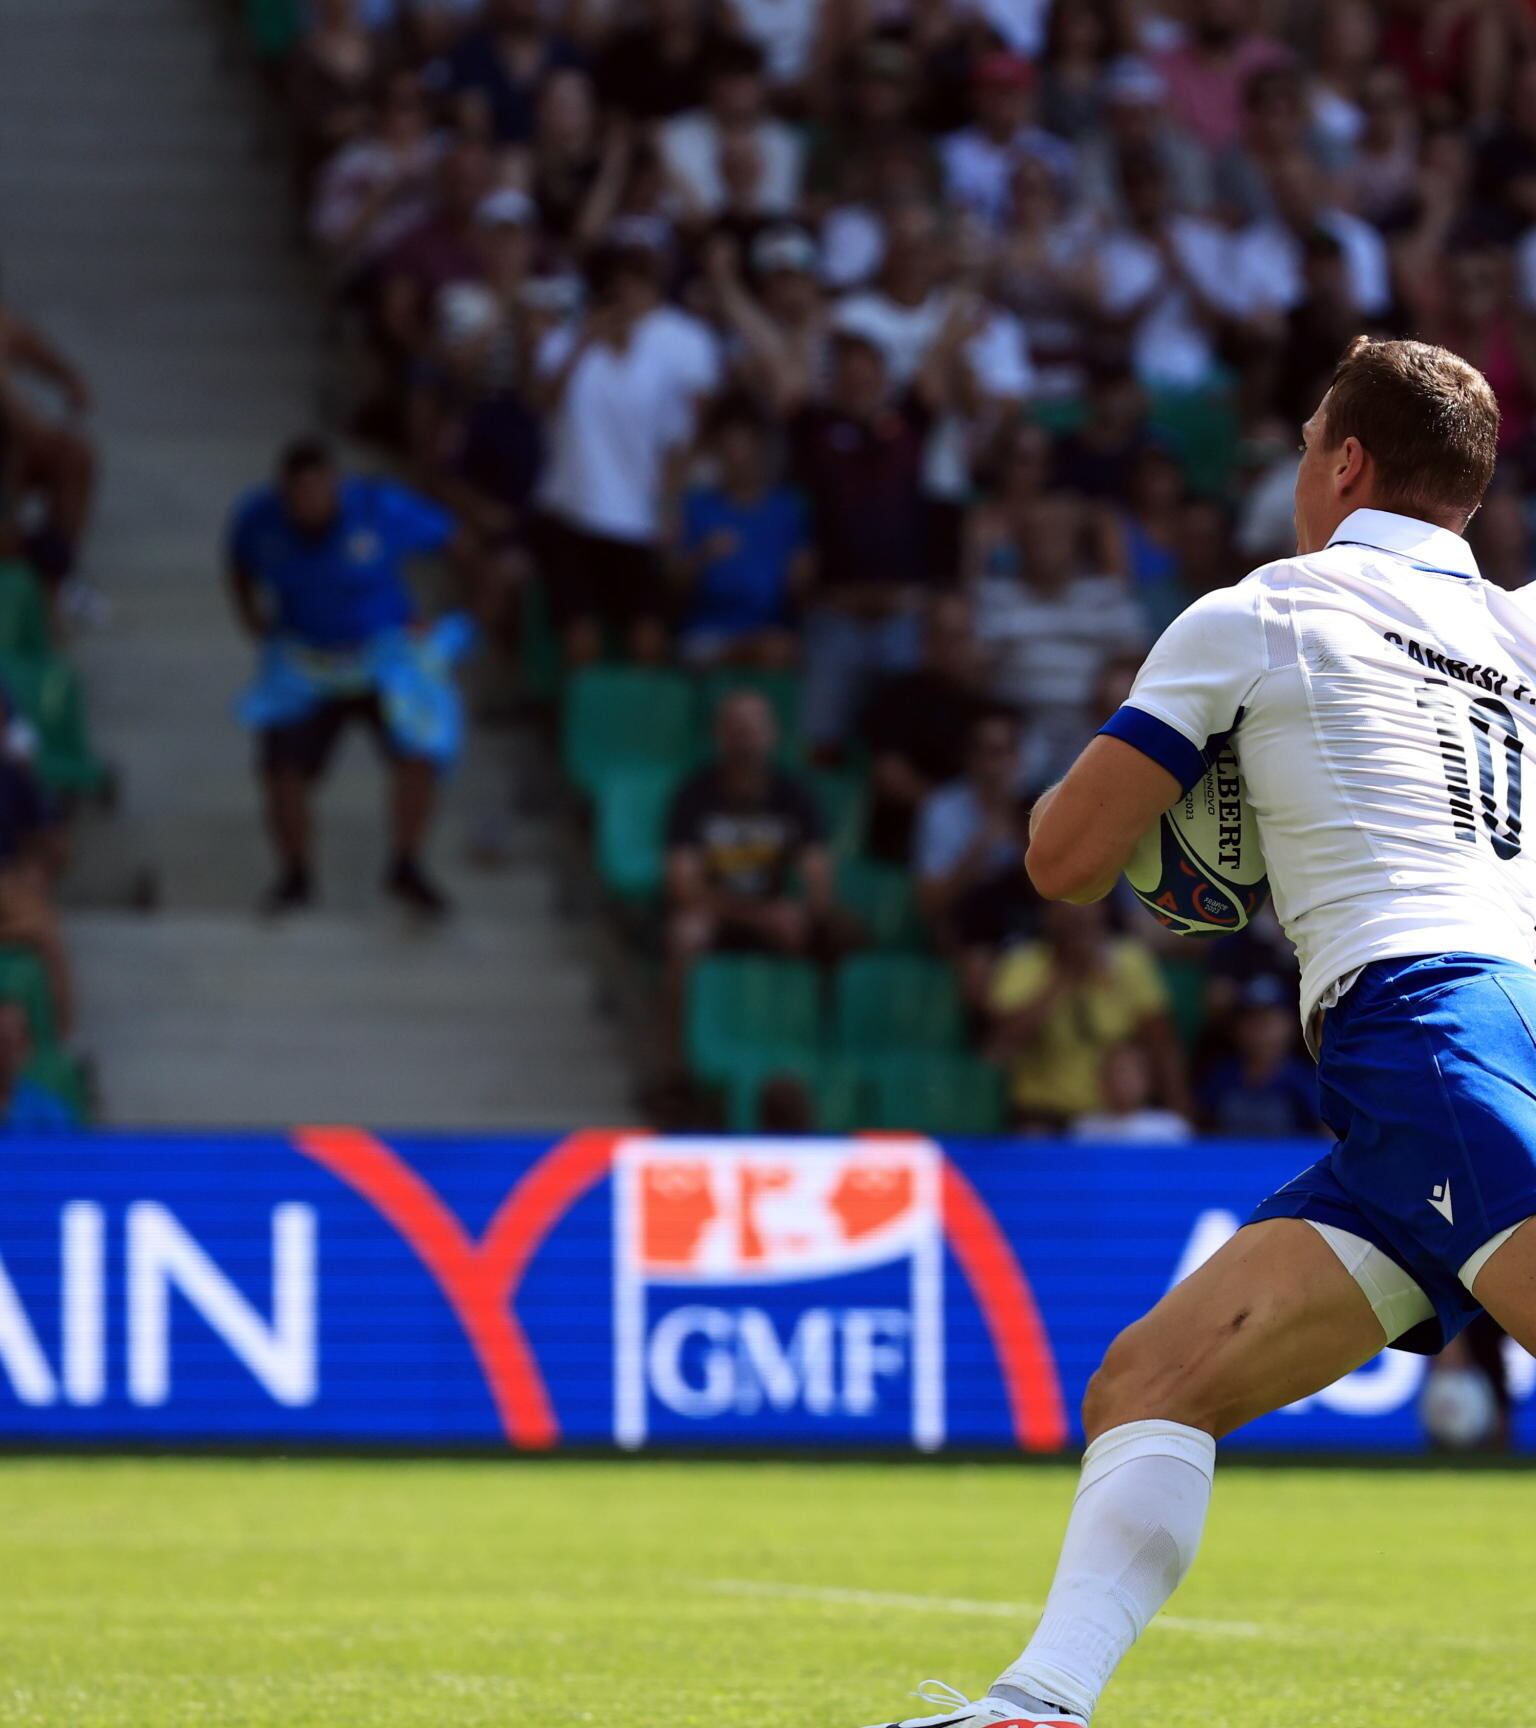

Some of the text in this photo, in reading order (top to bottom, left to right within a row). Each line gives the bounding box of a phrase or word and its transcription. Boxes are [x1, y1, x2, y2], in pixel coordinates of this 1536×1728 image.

[1206, 771, 1215, 816] NNOVO
[1216, 745, 1242, 870] LBERT
[1413, 677, 1524, 861] 10
[648, 1303, 912, 1420] GMF
